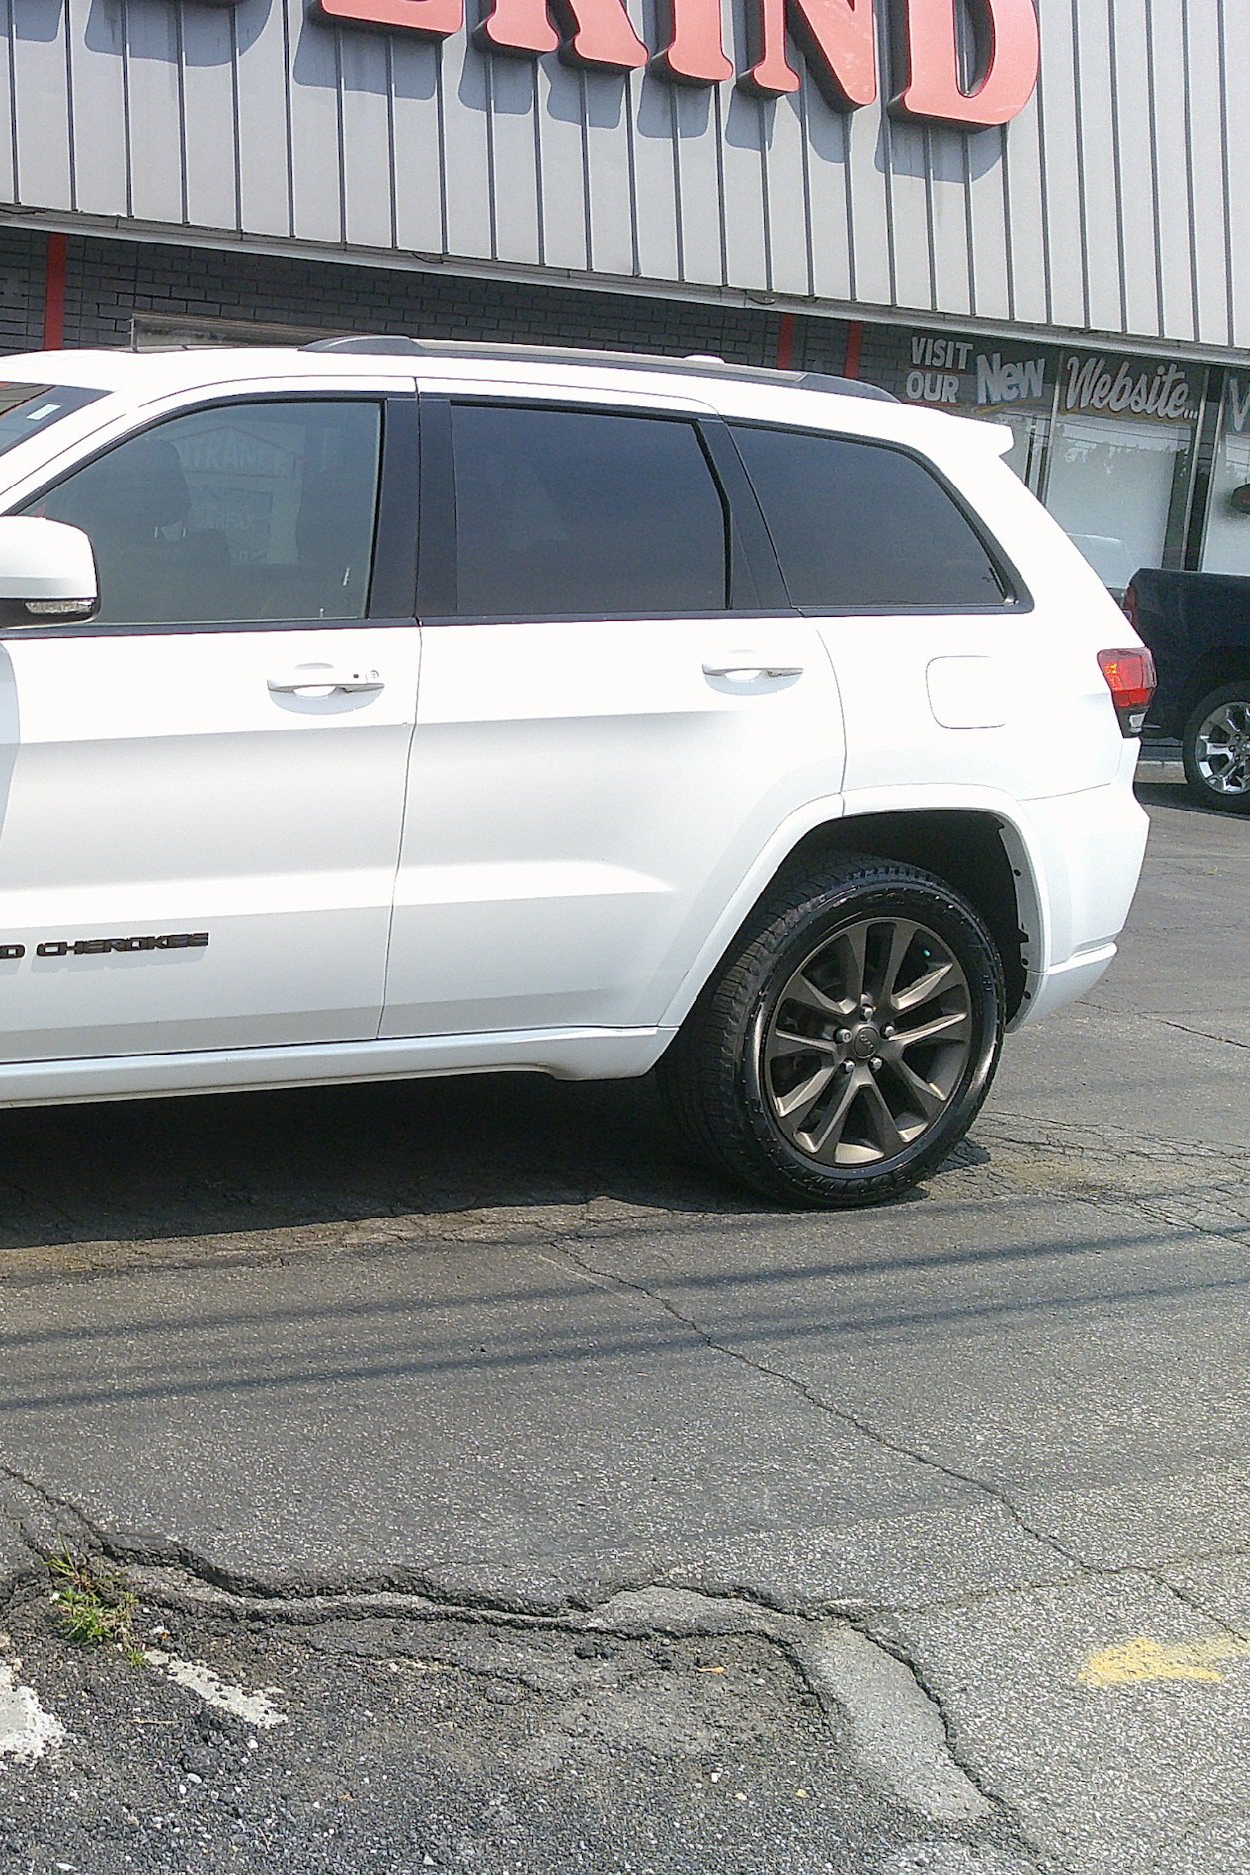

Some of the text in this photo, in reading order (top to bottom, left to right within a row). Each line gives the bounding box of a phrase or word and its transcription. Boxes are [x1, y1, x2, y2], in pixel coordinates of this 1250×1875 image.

[911, 336, 974, 370] VISIT
[906, 371, 959, 403] OUR
[976, 352, 1046, 404] New
[36, 932, 209, 957] CHEROKEE
